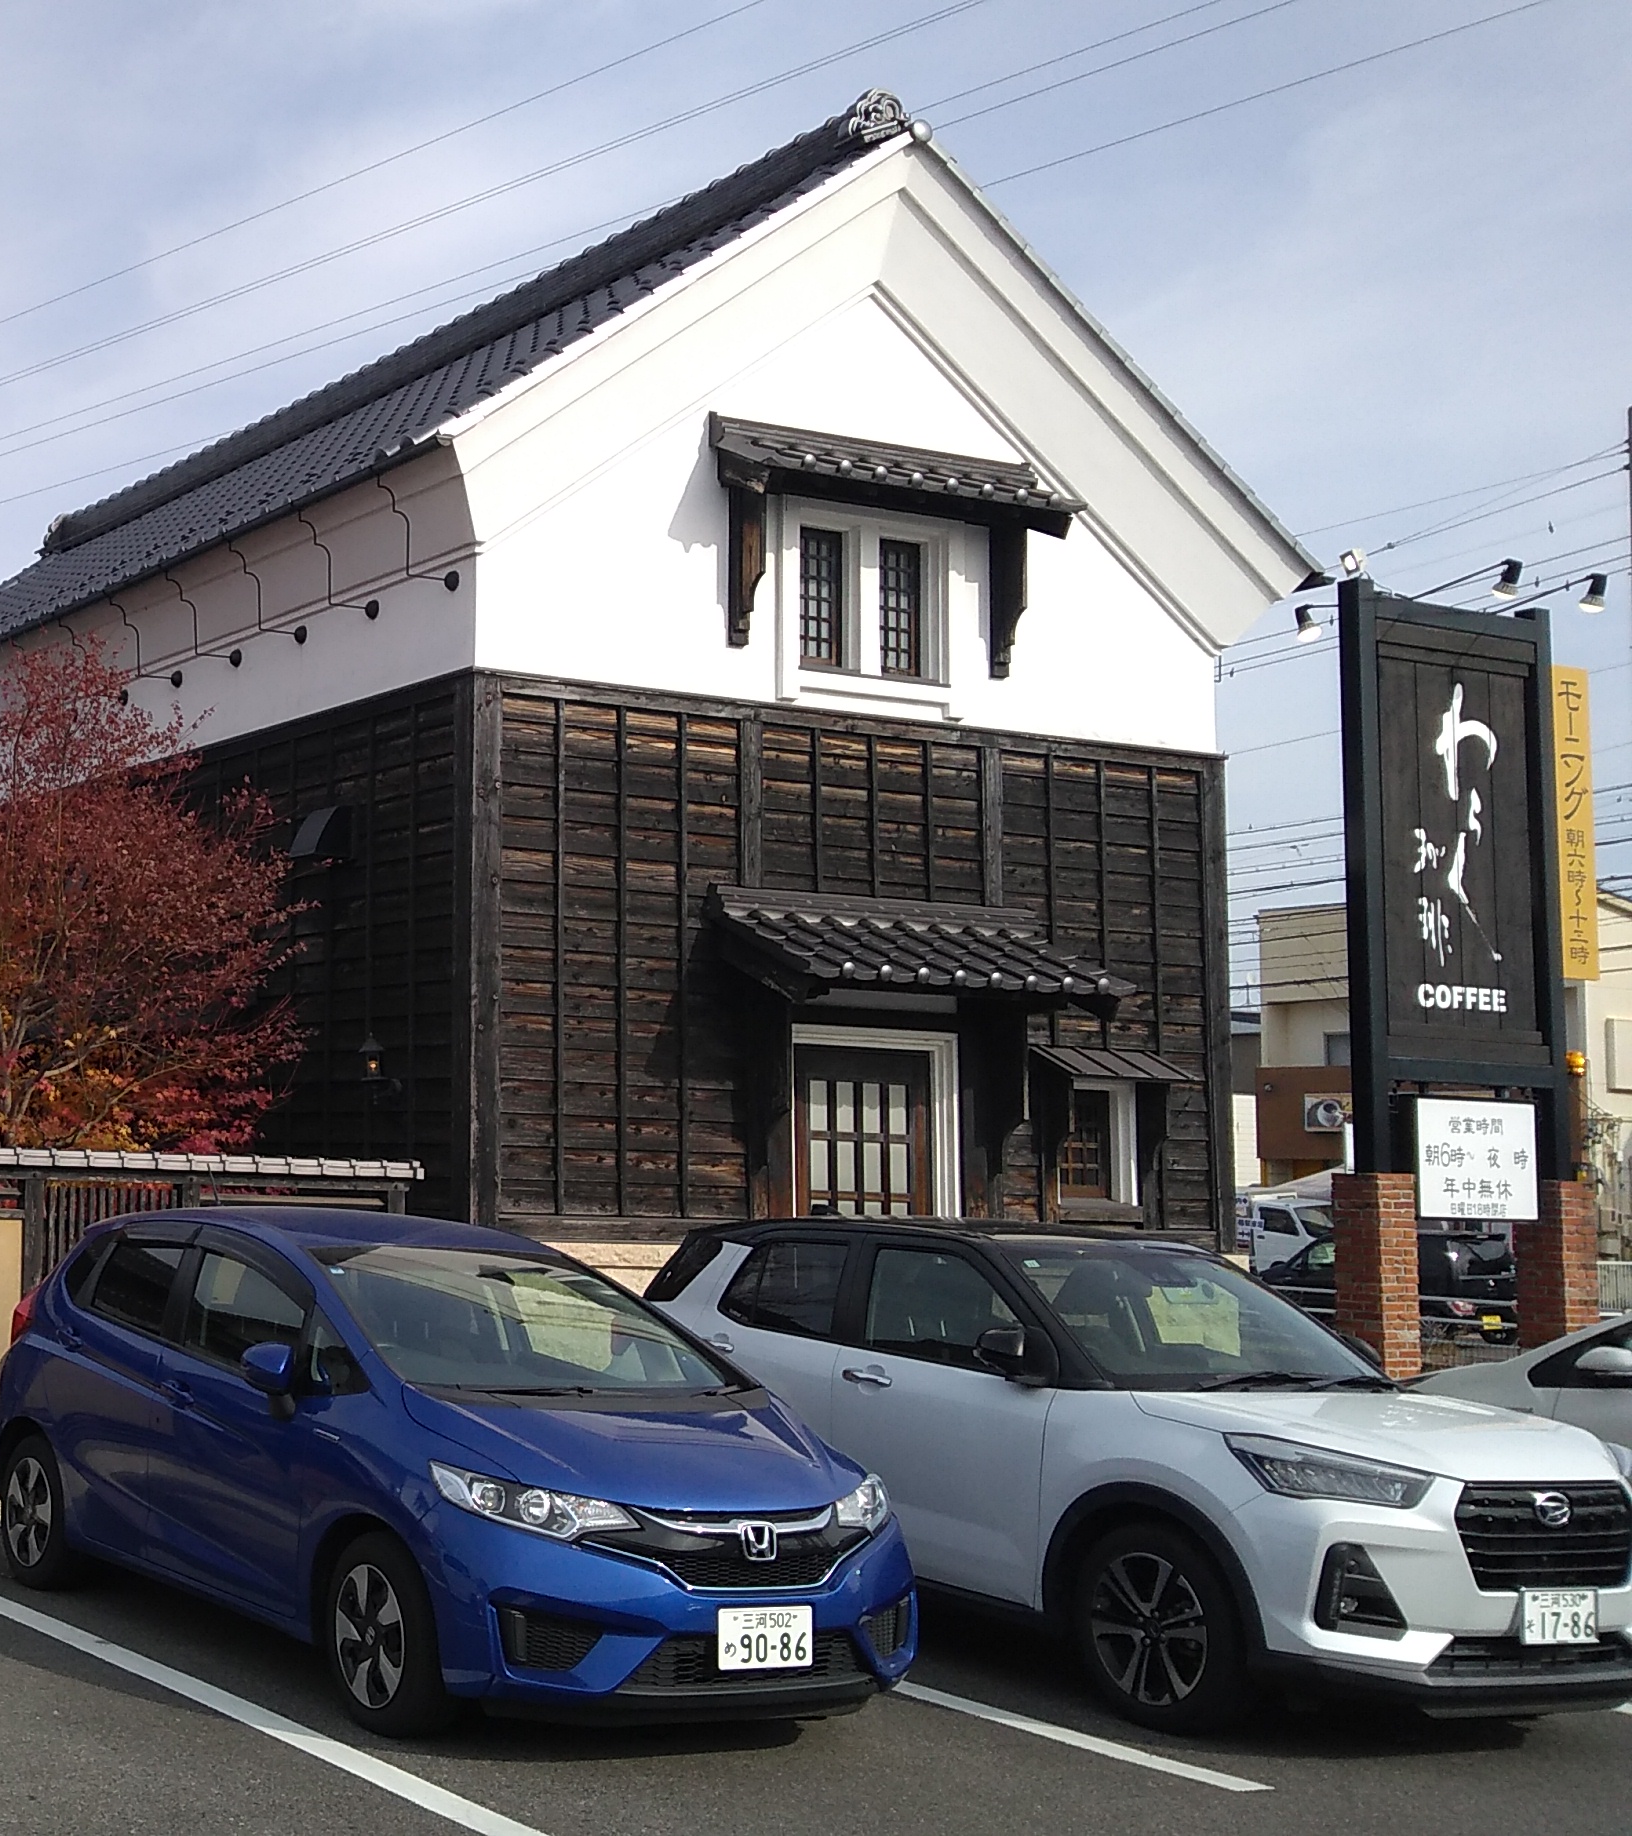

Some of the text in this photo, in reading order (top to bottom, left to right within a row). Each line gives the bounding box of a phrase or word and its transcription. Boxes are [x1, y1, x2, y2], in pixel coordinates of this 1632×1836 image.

[1557, 680, 1589, 820] モーニング
[1418, 983, 1508, 1013] COFFEE
[1448, 1116, 1504, 1135] 営業時間
[1487, 1147, 1501, 1169] 夜
[1513, 1148, 1529, 1170] 時
[1443, 1177, 1513, 1200] 年中無休
[1541, 1611, 1595, 1640] 17-86
[724, 1631, 807, 1663] め 90-86
